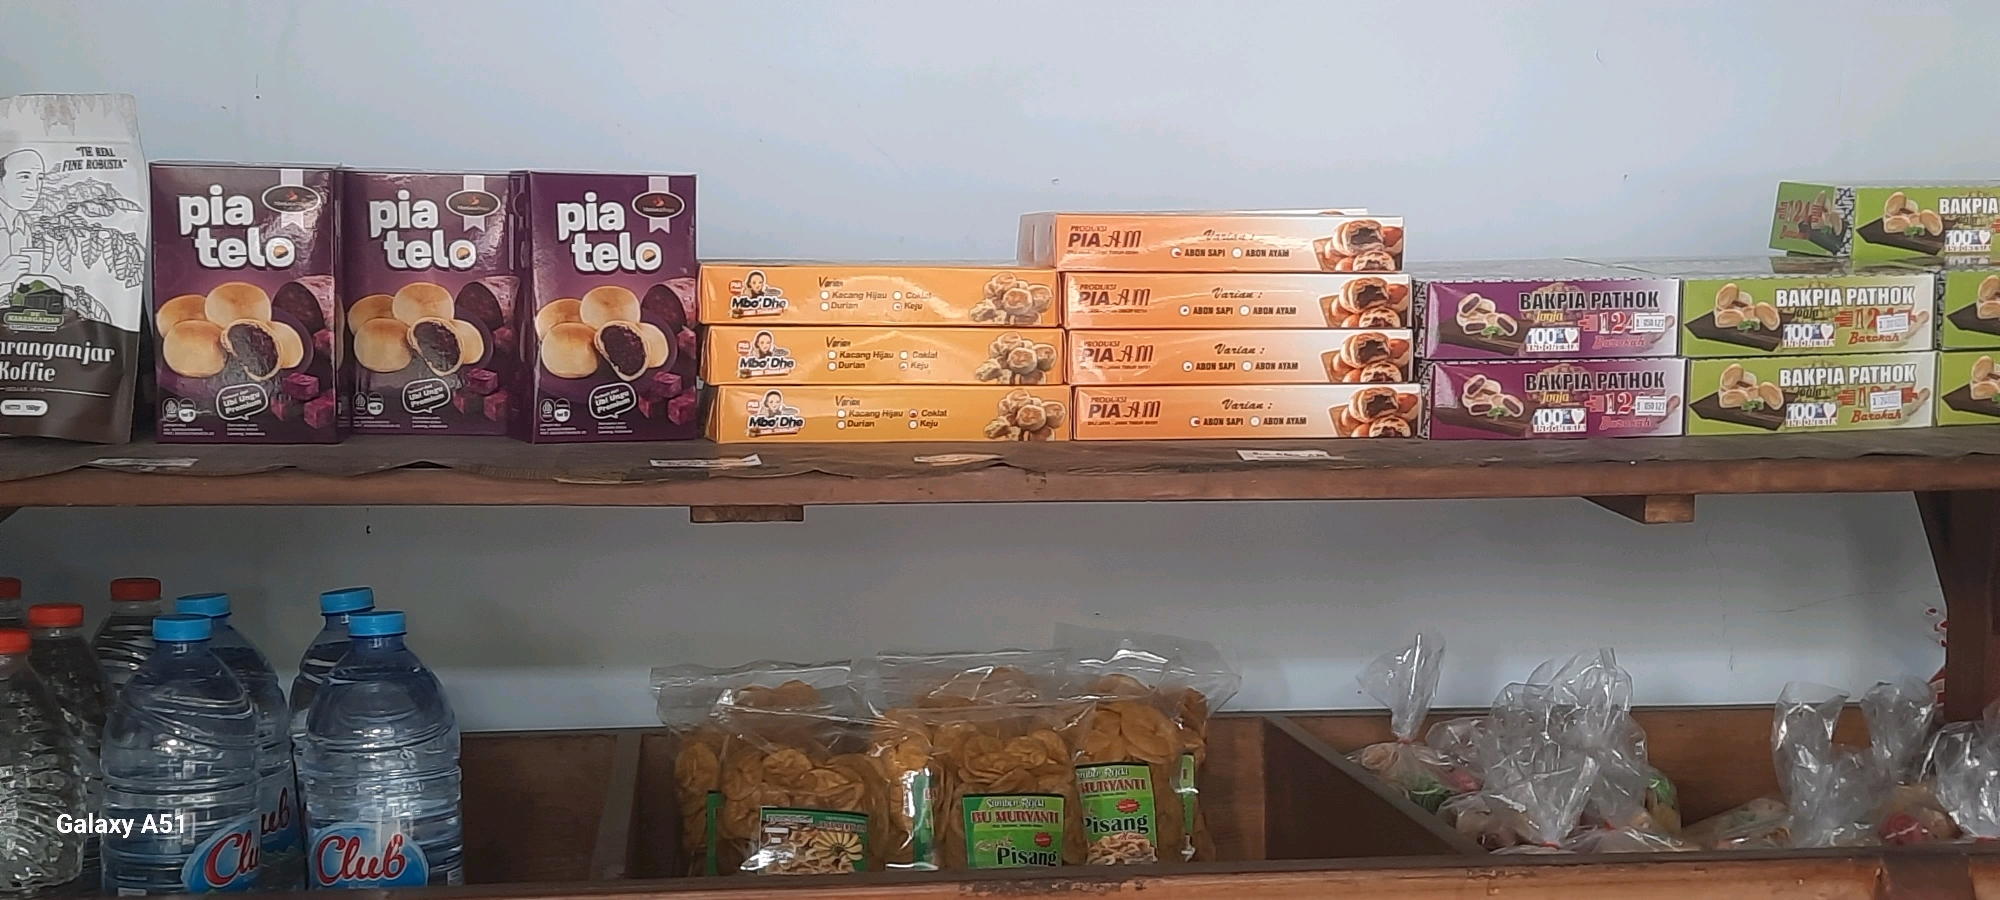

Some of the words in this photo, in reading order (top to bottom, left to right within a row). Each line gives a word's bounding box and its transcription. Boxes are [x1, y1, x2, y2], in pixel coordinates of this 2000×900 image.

[178, 184, 254, 235] pia
[1938, 197, 1999, 215] BAKPIA
[369, 189, 439, 238] pia
[556, 191, 626, 241] pia
[194, 227, 296, 268] telo
[1068, 233, 1101, 248] PIA
[383, 229, 477, 269] telo
[571, 231, 662, 272] telo
[1184, 249, 1206, 257] ABON
[1208, 249, 1225, 257] SAPI
[1245, 249, 1266, 257] ABON
[1268, 249, 1289, 257] AYAM
[832, 291, 864, 301] Kacang
[866, 291, 887, 300] Hijau
[1079, 291, 1111, 305] PIA
[1212, 287, 1254, 299] Varian
[1776, 288, 1843, 307] BAKPIA
[1846, 286, 1915, 306] PATHOK
[904, 302, 923, 311] Keju
[1520, 290, 1586, 311] BAKPIA
[1590, 290, 1659, 310] PATHOK
[839, 351, 871, 360] Kacang
[873, 351, 894, 360] Hijau
[1082, 348, 1114, 362] PIA
[1214, 343, 1256, 355] Varian
[0, 361, 56, 381] Koffie
[911, 362, 929, 370] Keju
[1196, 362, 1216, 370] ABON
[1218, 362, 1235, 370] SAPI
[1255, 362, 1275, 370] ABON
[1278, 362, 1298, 370] AYAM
[1525, 373, 1592, 392] BAKPIA
[1596, 371, 1665, 391] PATHOK
[1779, 367, 1845, 387] BAKPIA
[1848, 364, 1917, 385] PATHOK
[1088, 404, 1121, 419] PIA
[1222, 399, 1264, 410] Varian
[848, 409, 880, 418] Kacang
[882, 410, 903, 418] Hijau
[921, 409, 947, 417] Coklat
[1851, 409, 1902, 423] Barokah
[847, 420, 875, 428] Durian
[920, 420, 938, 428] Keju
[1263, 417, 1284, 425] ABON
[1286, 417, 1306, 425] AYAM
[971, 811, 992, 823] BU
[995, 810, 1059, 823] MURYANTI
[317, 834, 406, 886] Club
[996, 846, 1057, 867] Pisang
